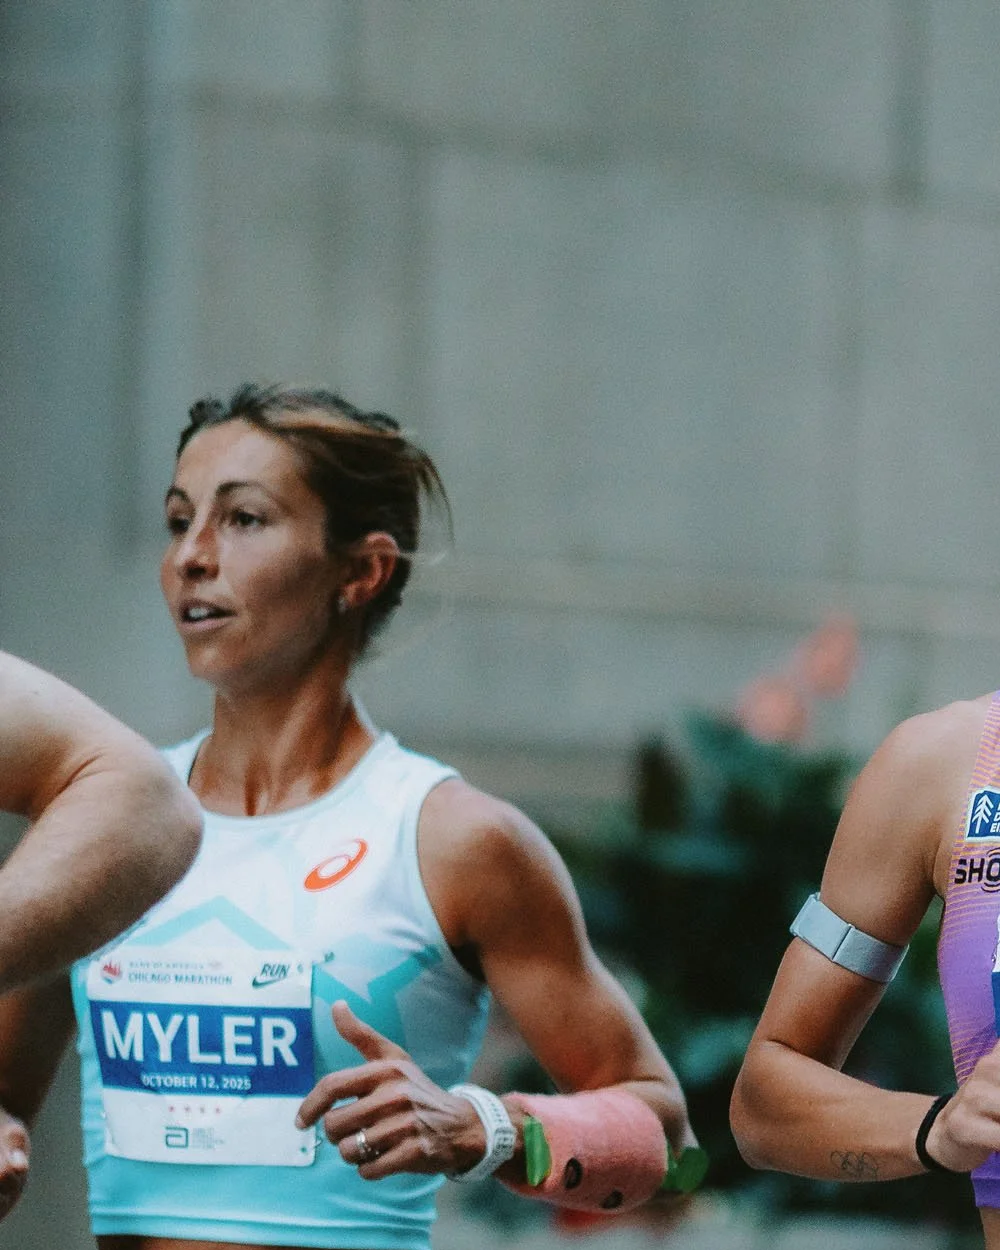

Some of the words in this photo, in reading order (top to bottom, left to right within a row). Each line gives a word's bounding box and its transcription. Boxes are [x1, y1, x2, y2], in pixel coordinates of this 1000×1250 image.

[260, 963, 290, 977] RUN
[128, 972, 171, 984] CHICAGO
[174, 973, 233, 985] MARATHON
[101, 1010, 299, 1067] MYLER
[142, 1073, 197, 1088] OCTOBER
[201, 1075, 220, 1090] 12,
[223, 1076, 252, 1090] 2025
